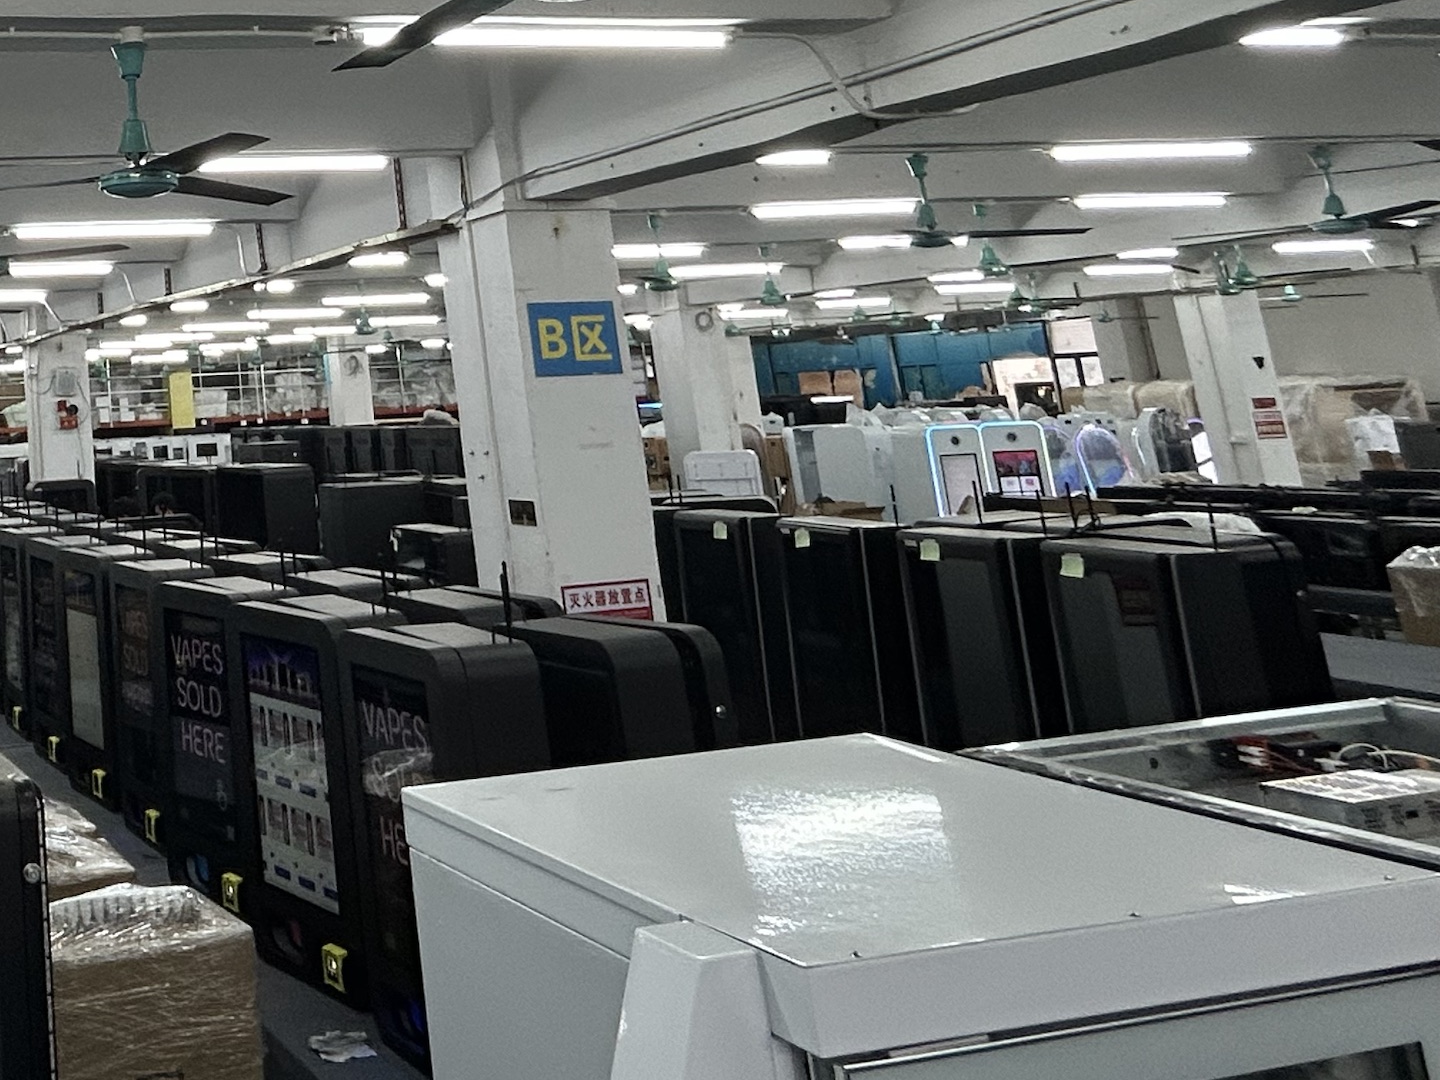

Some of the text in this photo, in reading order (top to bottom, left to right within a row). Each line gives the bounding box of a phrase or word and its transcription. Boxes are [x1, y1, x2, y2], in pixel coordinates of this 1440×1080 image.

[537, 314, 613, 362] B区
[568, 586, 646, 609] 灭火器放置点
[170, 634, 224, 675] VAPES
[176, 677, 222, 718] SOLD
[181, 721, 226, 764] HERE
[361, 699, 428, 756] VAPES
